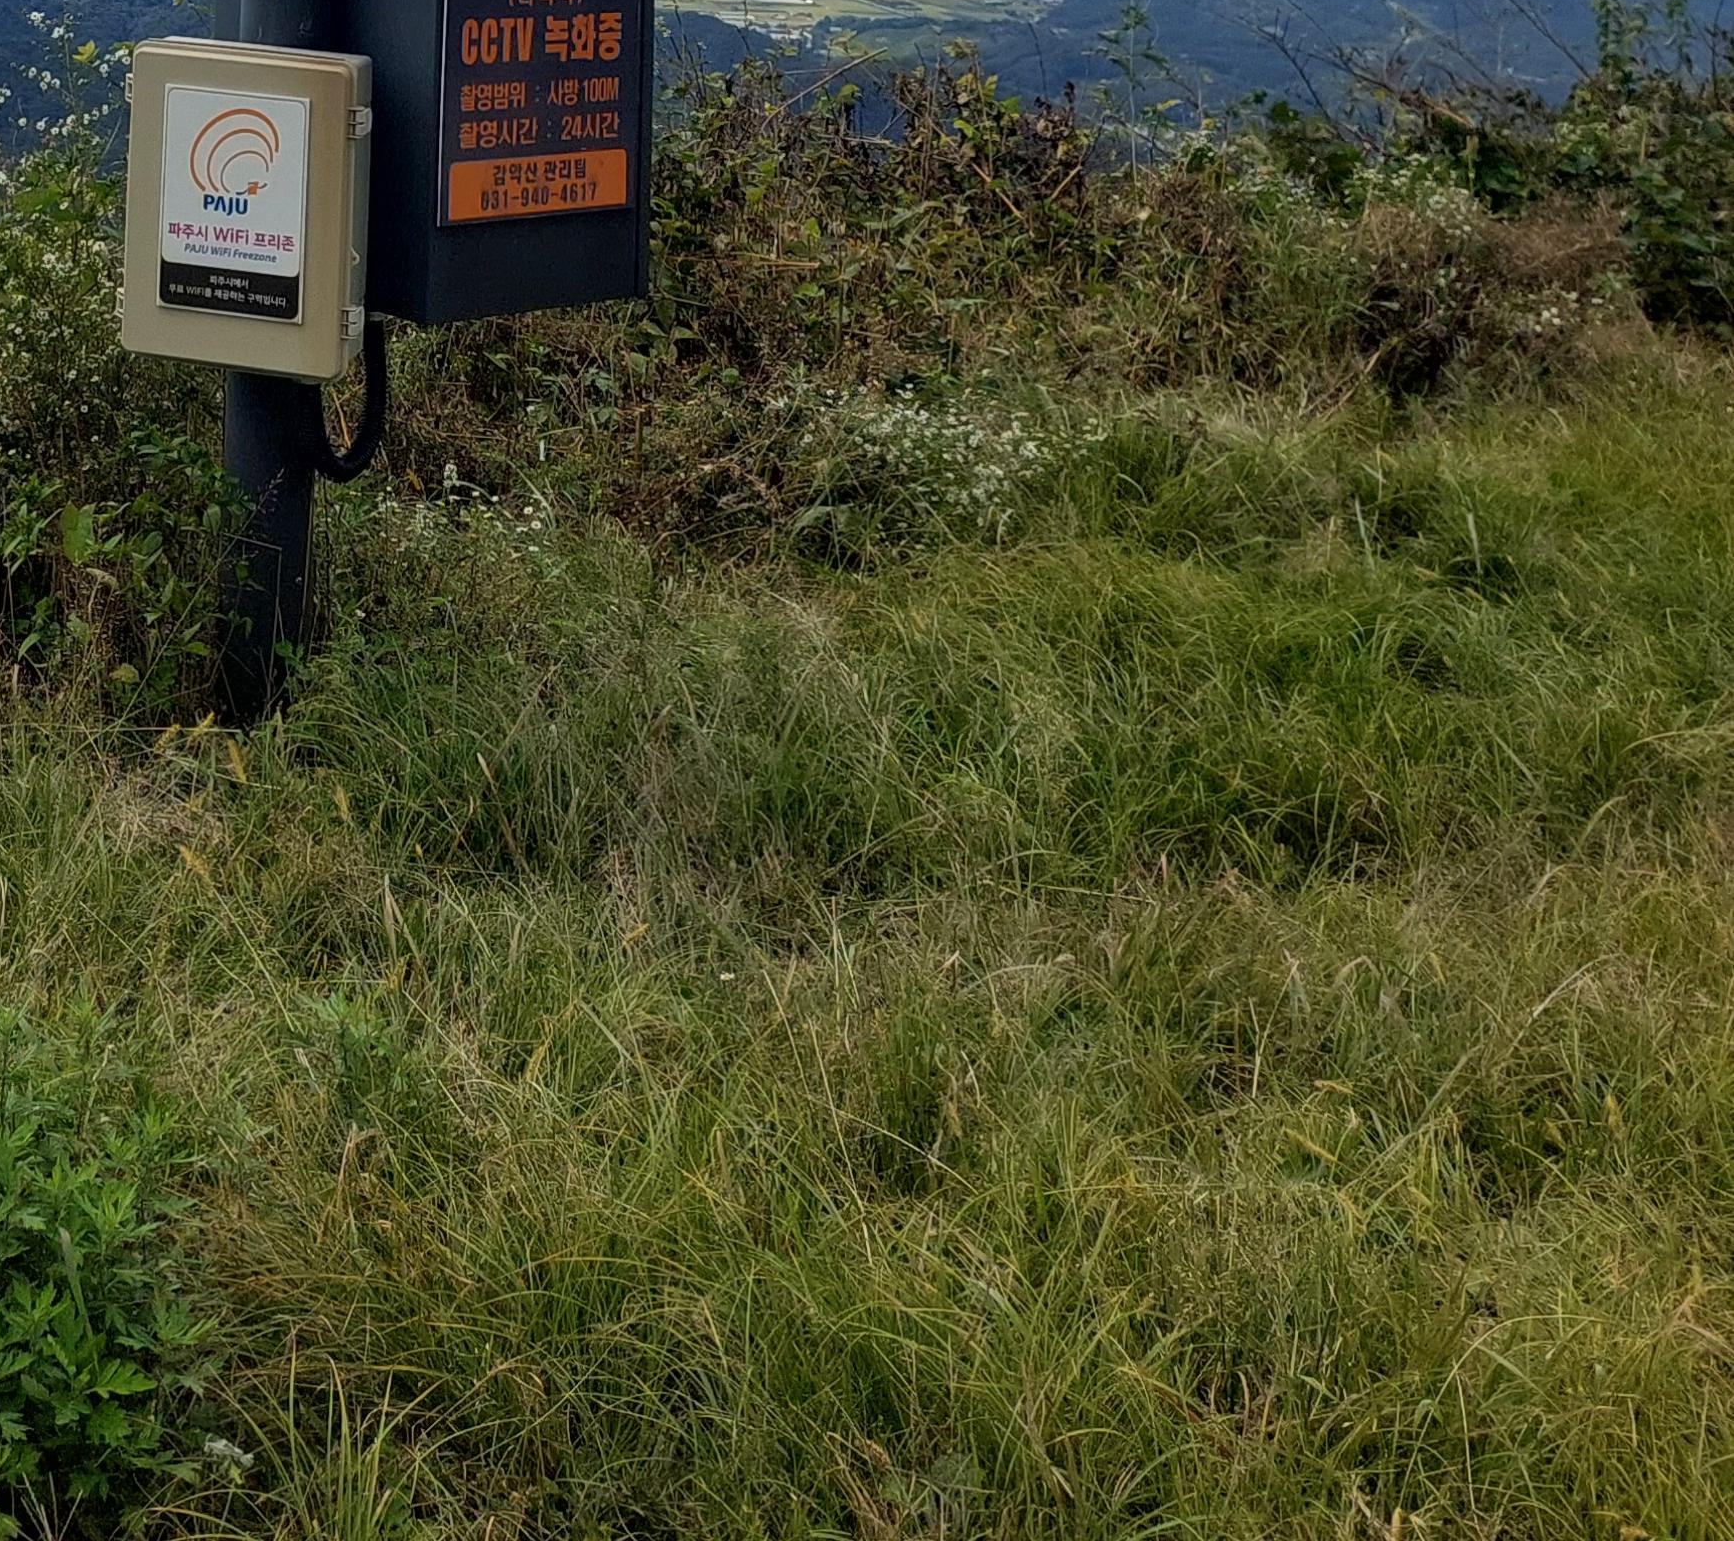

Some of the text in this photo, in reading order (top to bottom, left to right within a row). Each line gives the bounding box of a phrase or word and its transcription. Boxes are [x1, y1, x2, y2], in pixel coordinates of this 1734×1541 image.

[461, 17, 534, 66] CCTV
[546, 78, 580, 107] 사방
[582, 76, 620, 103] 100M
[458, 117, 538, 150] 촬영시간
[561, 111, 620, 141] 24시간
[492, 163, 539, 187] 감악산
[203, 193, 249, 216] PAJU
[480, 181, 597, 212] 031-940-4617
[167, 222, 295, 252] 파주시 WiFi 프리존
[184, 243, 277, 263] PAJU WiFi Freezone
